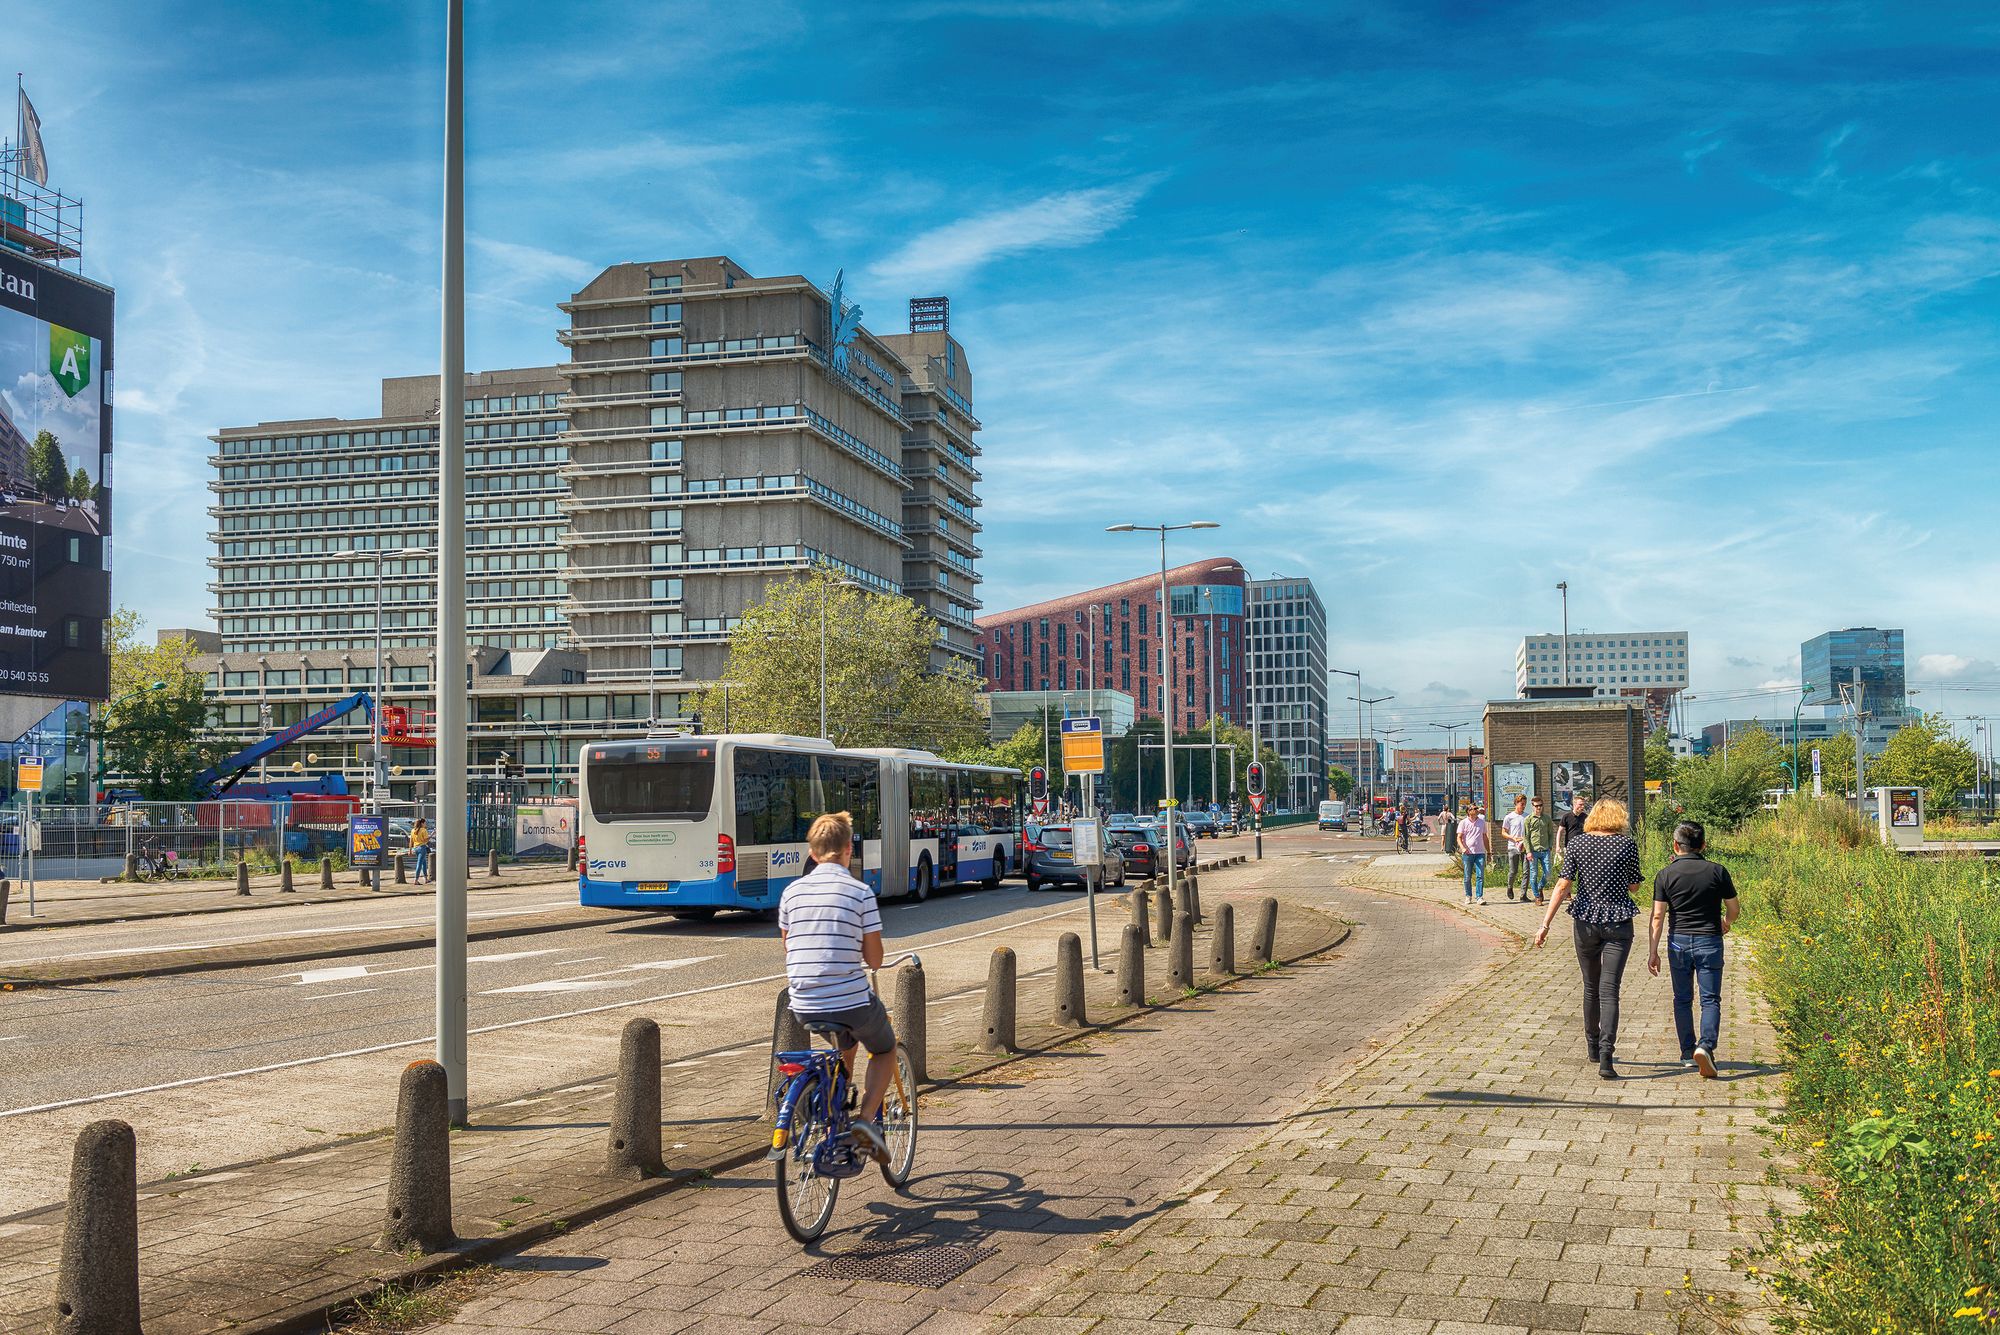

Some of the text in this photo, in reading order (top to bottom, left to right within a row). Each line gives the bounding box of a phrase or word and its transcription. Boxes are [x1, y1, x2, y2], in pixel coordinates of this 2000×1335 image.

[1, 554, 17, 567] 750
[0, 600, 37, 615] chitecten
[15, 625, 47, 638] kantoor
[10, 670, 26, 682] 540
[27, 671, 37, 682] 55
[39, 672, 49, 683] 55
[647, 747, 660, 759] 55
[522, 824, 556, 835] Lomans
[785, 850, 800, 864] GVB
[607, 860, 627, 868] GVB
[699, 860, 714, 868] 338
